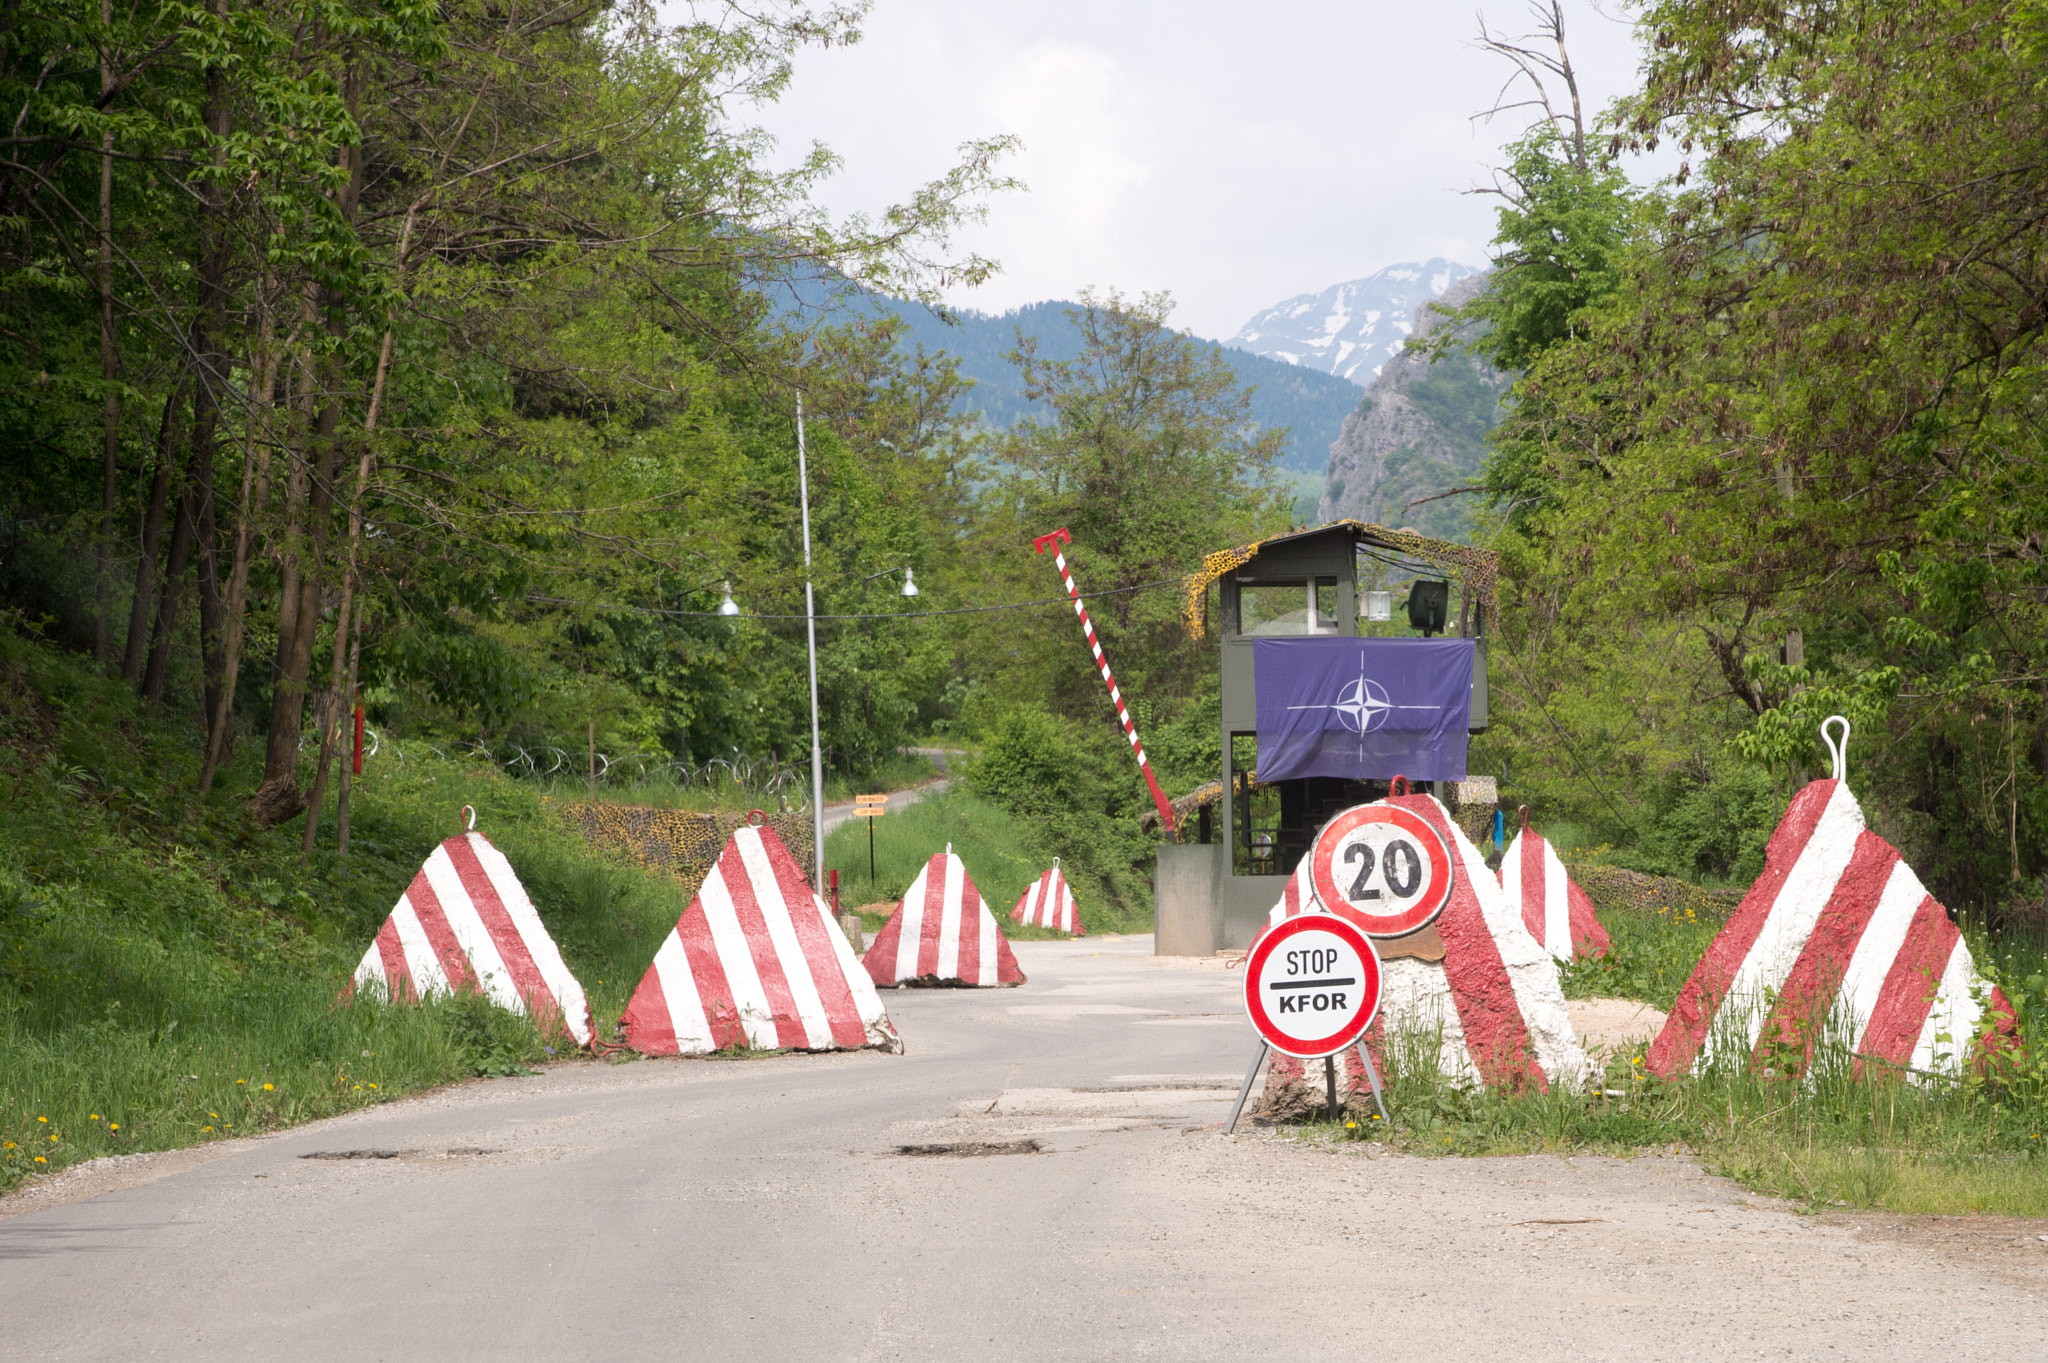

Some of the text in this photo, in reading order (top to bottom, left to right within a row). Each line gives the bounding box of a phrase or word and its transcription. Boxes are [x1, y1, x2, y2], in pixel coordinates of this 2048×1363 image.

[1343, 839, 1422, 902] 20
[1286, 948, 1338, 976] STOP
[1279, 992, 1348, 1014] KFOR
